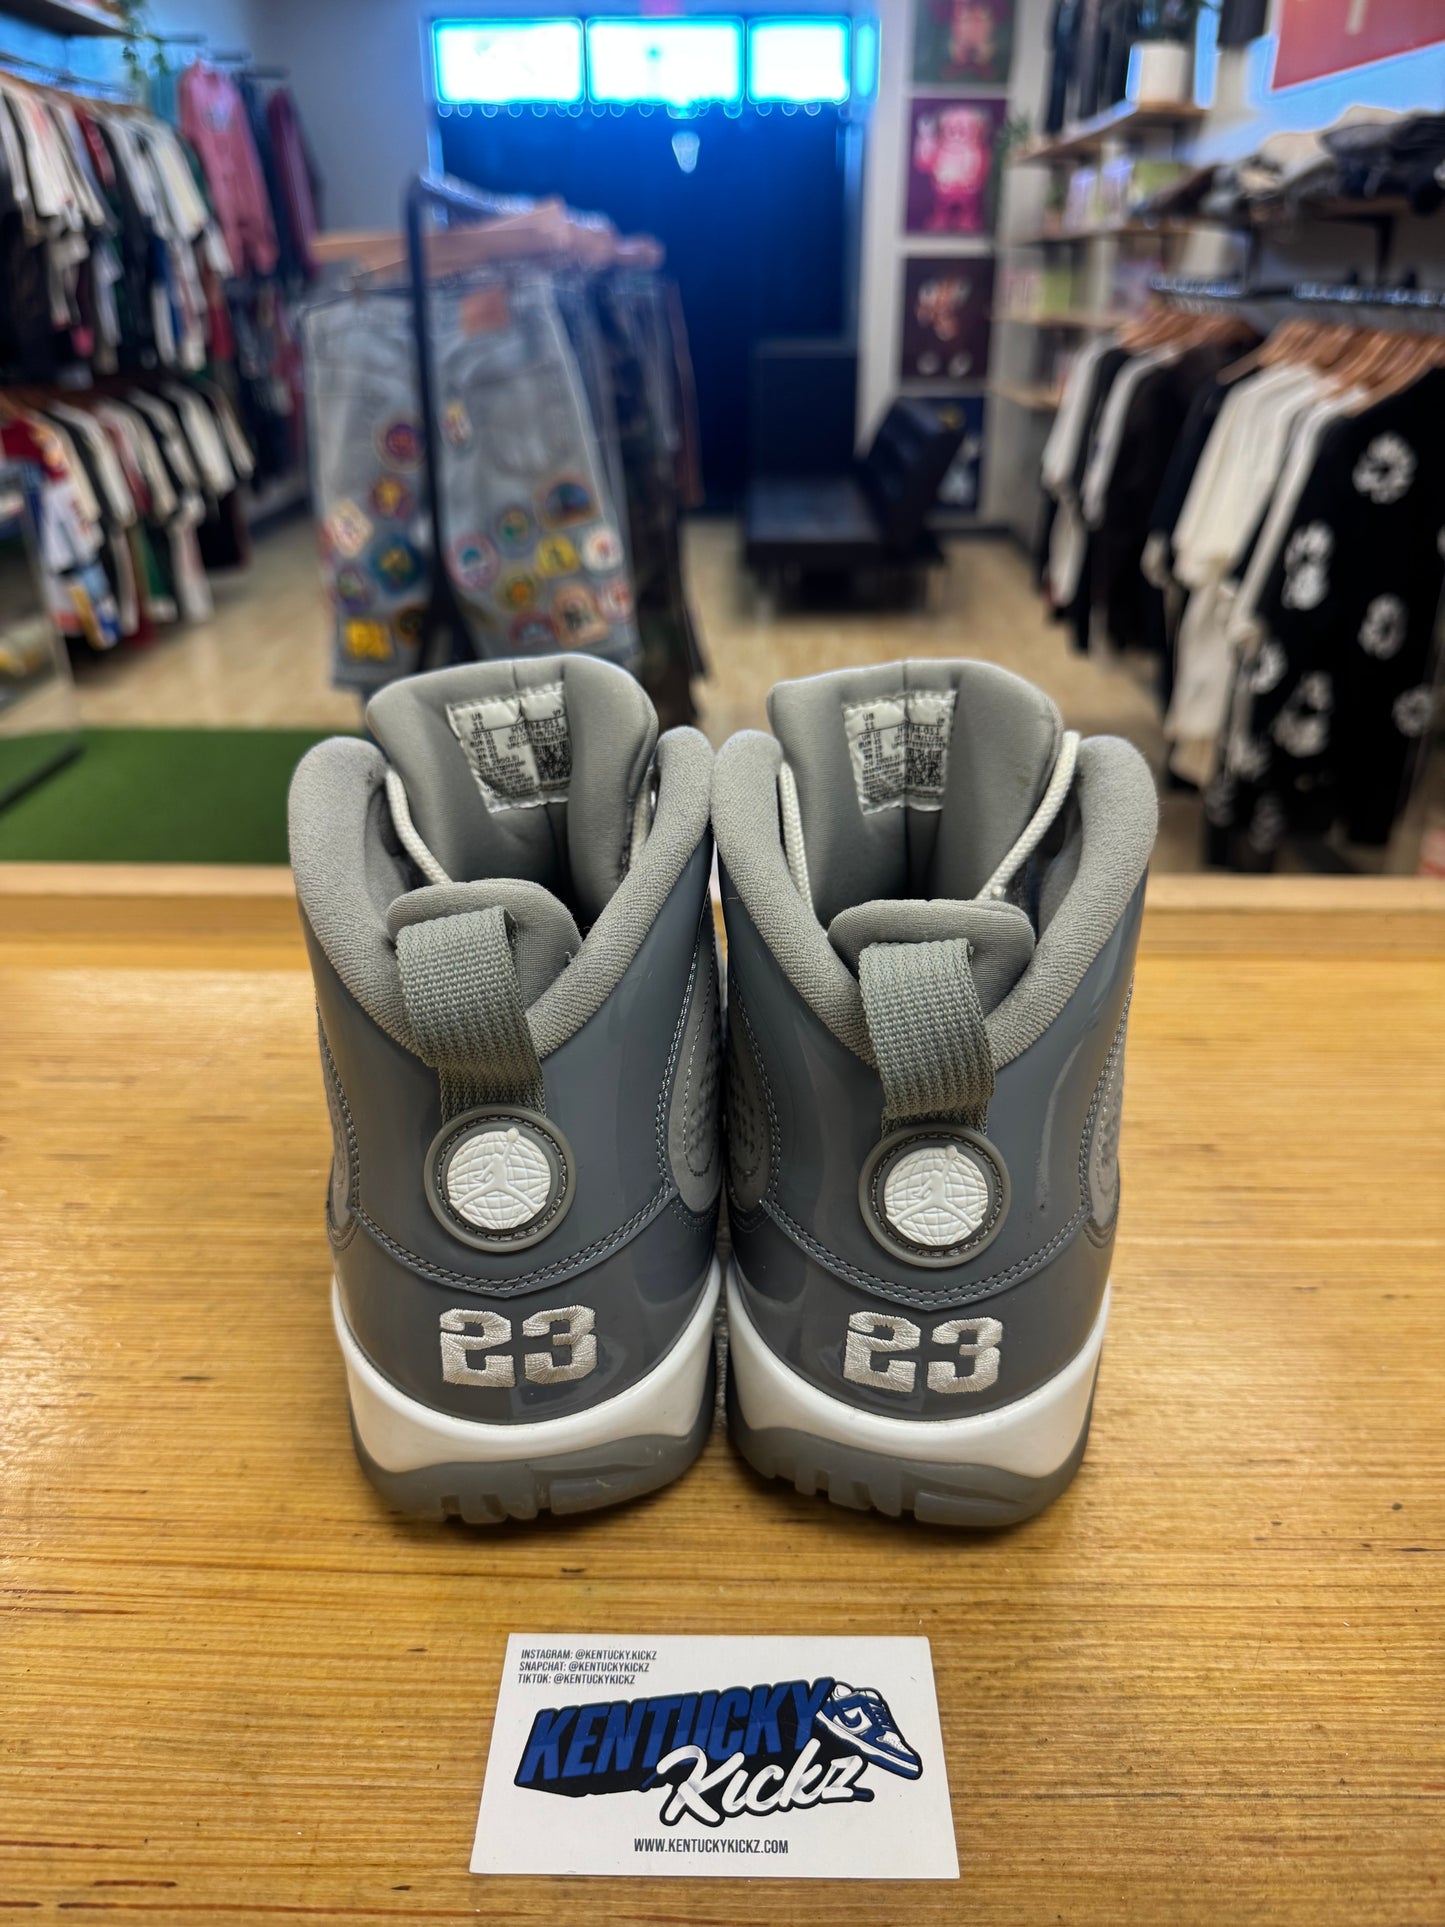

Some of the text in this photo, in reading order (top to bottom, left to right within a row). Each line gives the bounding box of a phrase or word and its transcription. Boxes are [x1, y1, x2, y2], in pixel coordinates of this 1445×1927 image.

[439, 1304, 597, 1388] 23
[842, 1310, 1003, 1394] 23
[517, 1673, 636, 1685] TIKTOK: @KENTUCKYKICKZ
[519, 1660, 650, 1673] SNAPCHAT: @KENTUCKYKICKZ
[520, 1648, 657, 1661] INSTAGRAM: @KENTUCKY.KICKZ
[516, 1677, 836, 1786] KENTUCKY
[655, 1737, 866, 1824] Kickz
[633, 1837, 789, 1854] WWW.KENTUCKYKICKZ.COM
